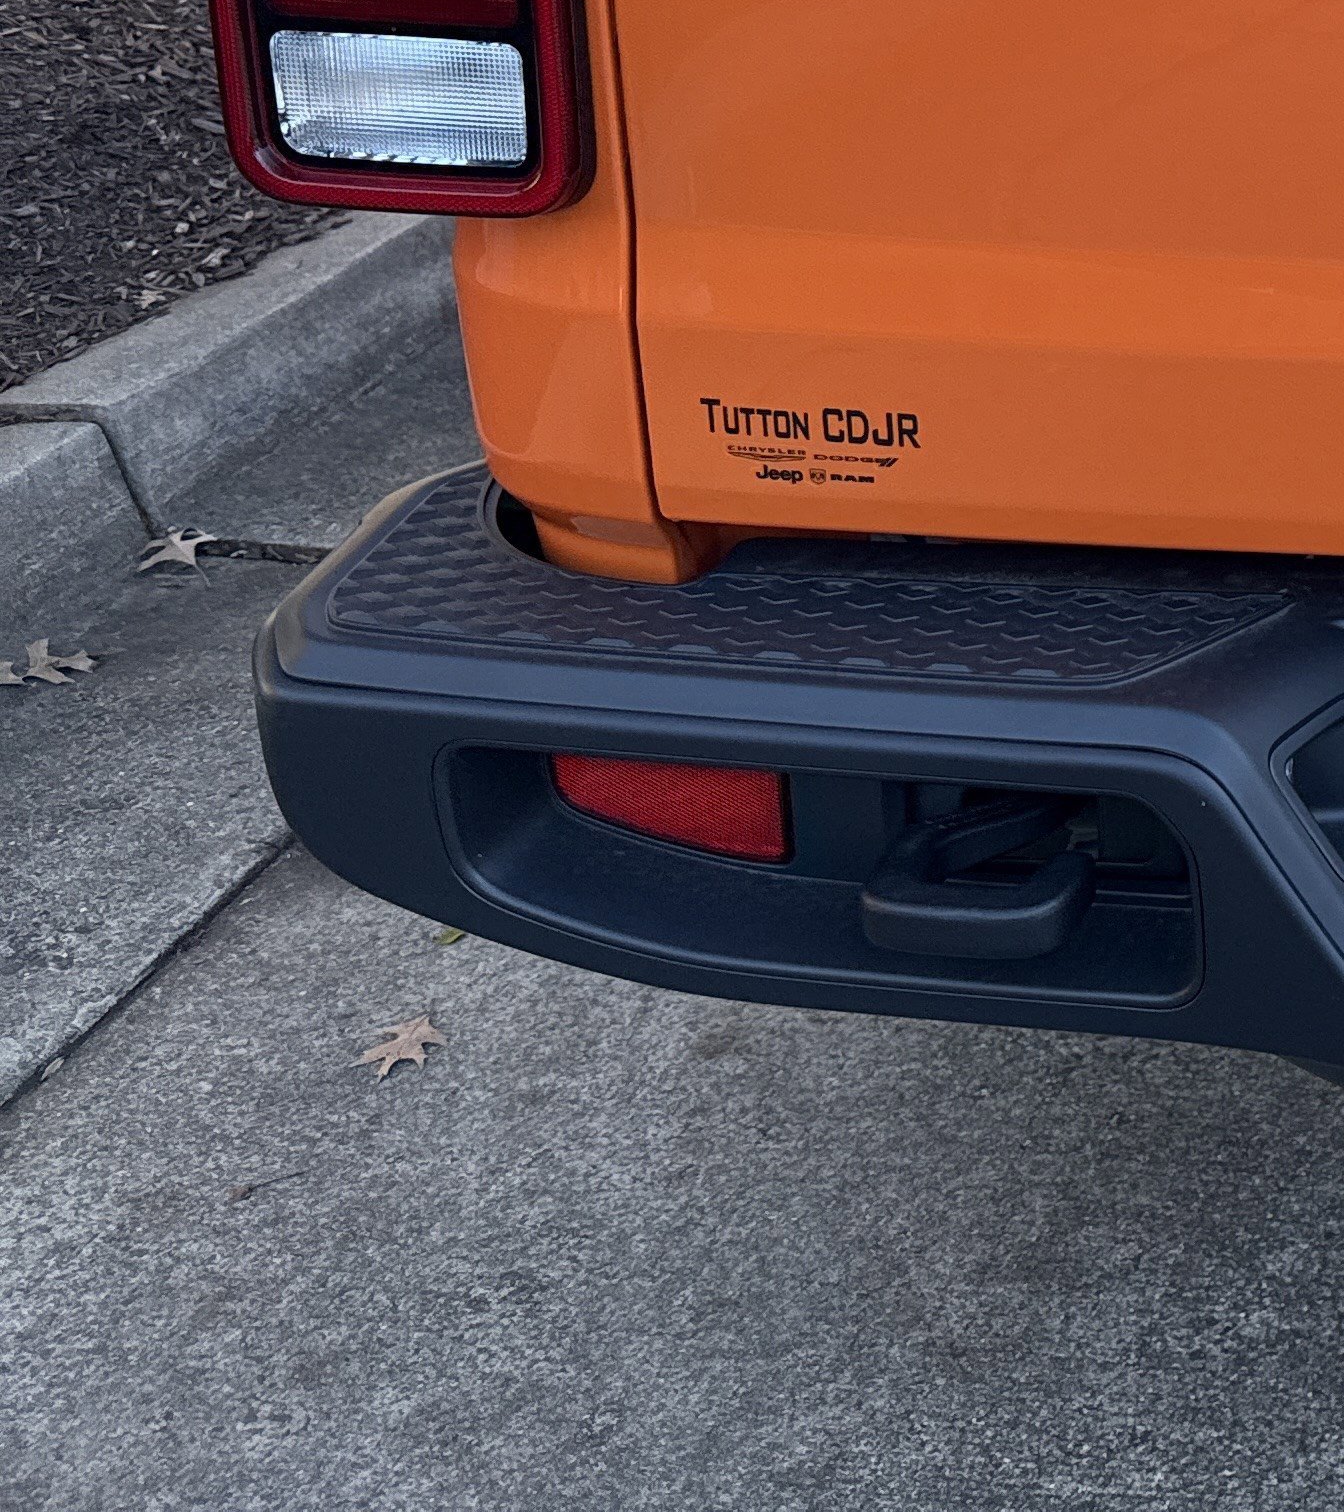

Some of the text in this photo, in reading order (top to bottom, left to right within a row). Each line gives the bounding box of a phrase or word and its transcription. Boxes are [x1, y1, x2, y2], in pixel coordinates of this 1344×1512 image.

[700, 397, 922, 449] TUTTON CDJR
[755, 464, 875, 484] Jeep RAM
